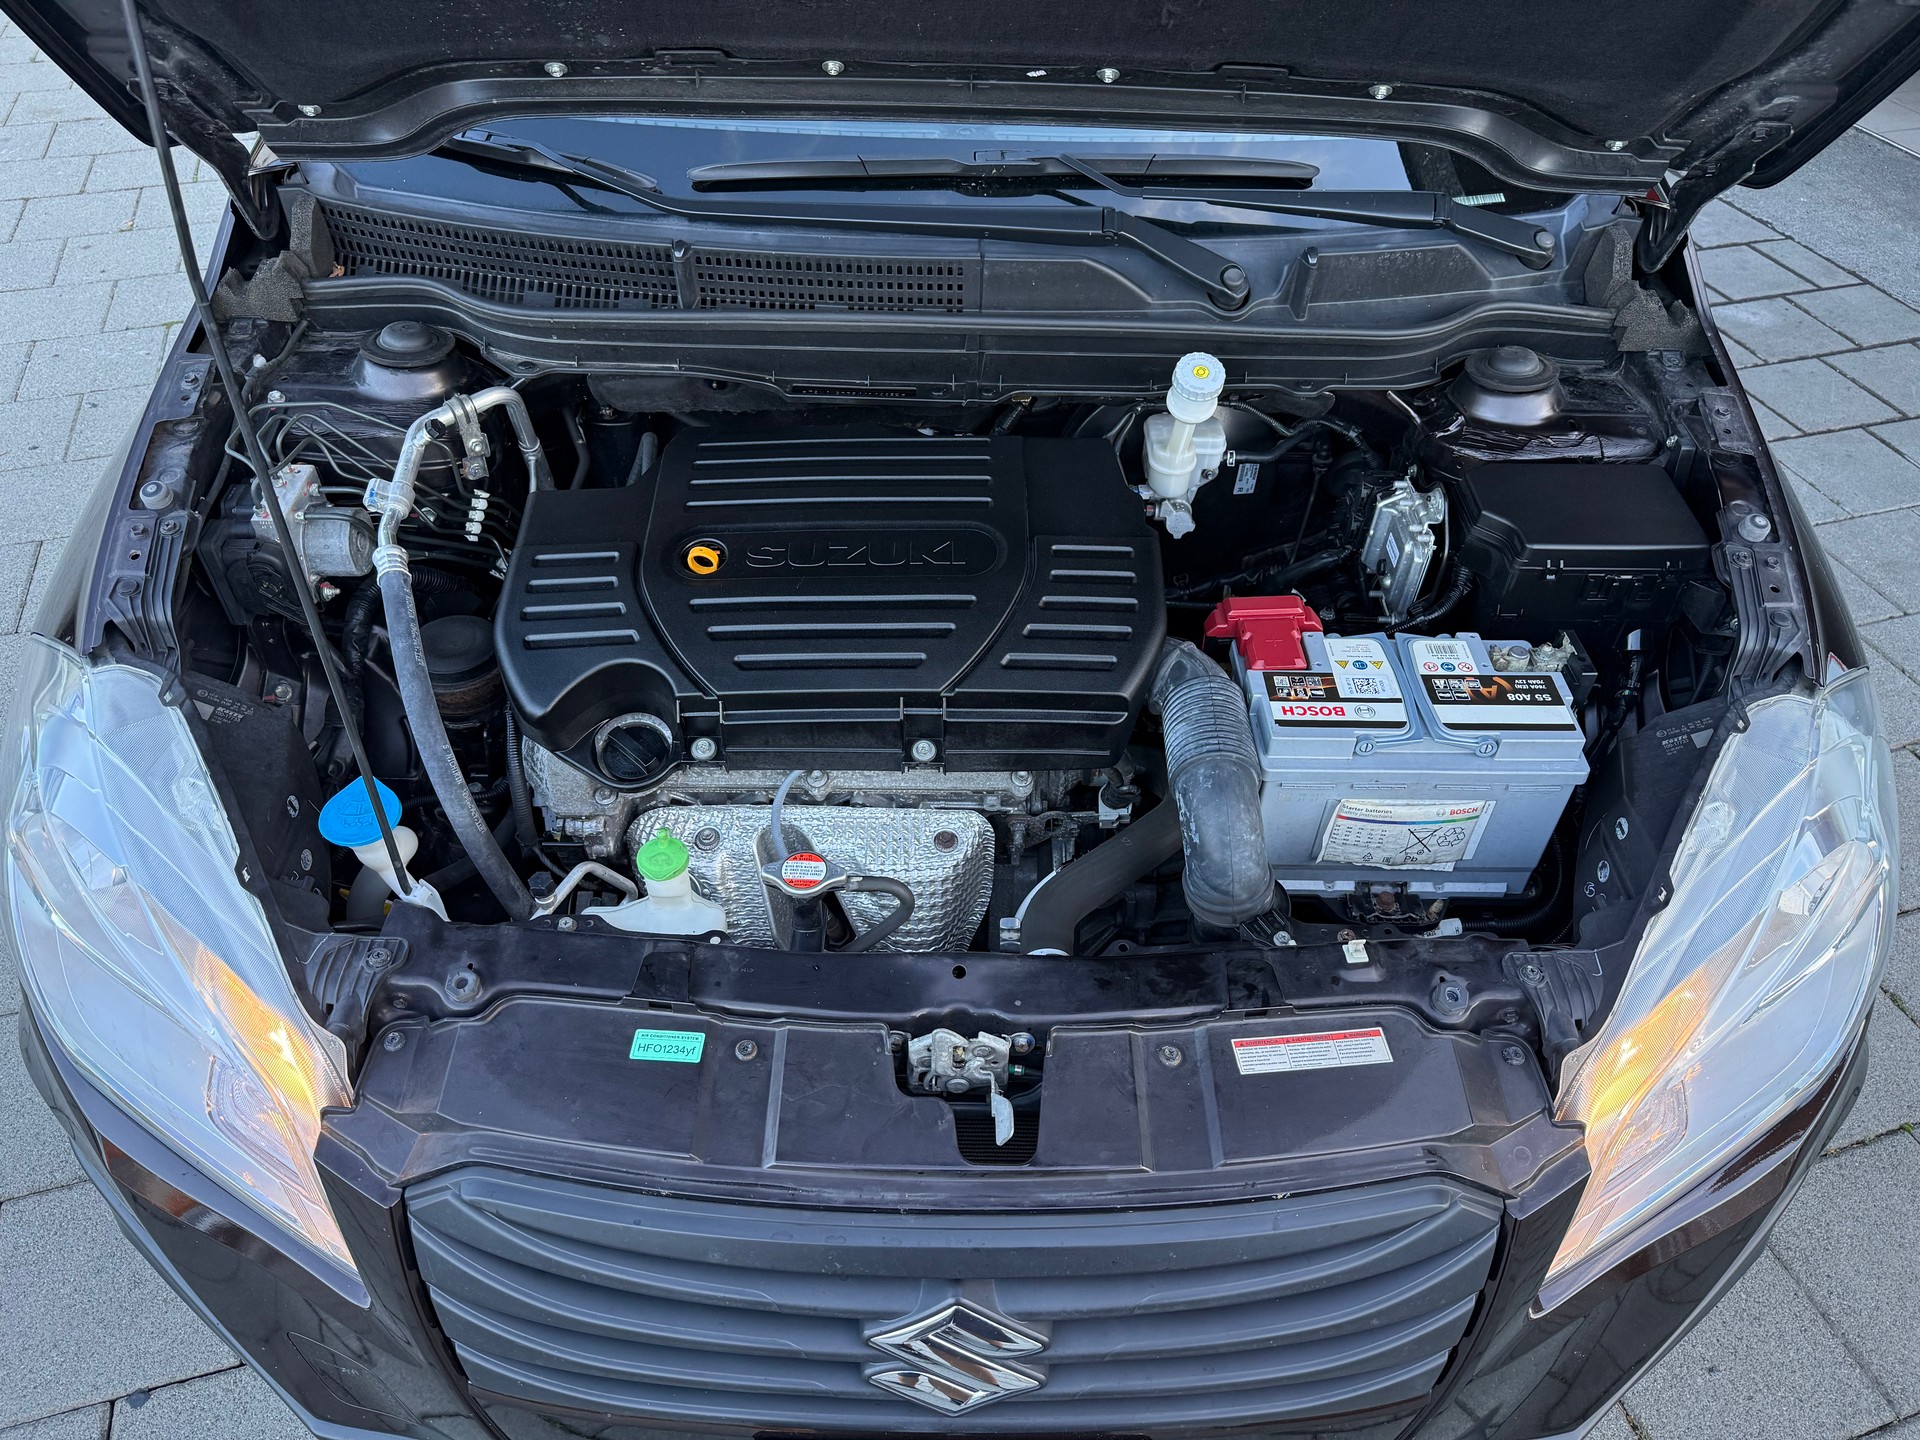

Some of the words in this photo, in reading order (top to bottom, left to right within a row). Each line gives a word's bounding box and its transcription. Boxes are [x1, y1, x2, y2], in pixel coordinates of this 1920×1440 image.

[746, 540, 966, 568] SUZUKI
[1506, 693, 1531, 701] A08
[1534, 693, 1552, 701] S5
[1281, 706, 1346, 716] BOSCH
[446, 753, 463, 785] NICHIRIN
[1342, 804, 1363, 812] Starter
[1450, 807, 1478, 816] BOSCH
[637, 1043, 697, 1057] HFO1234yf
